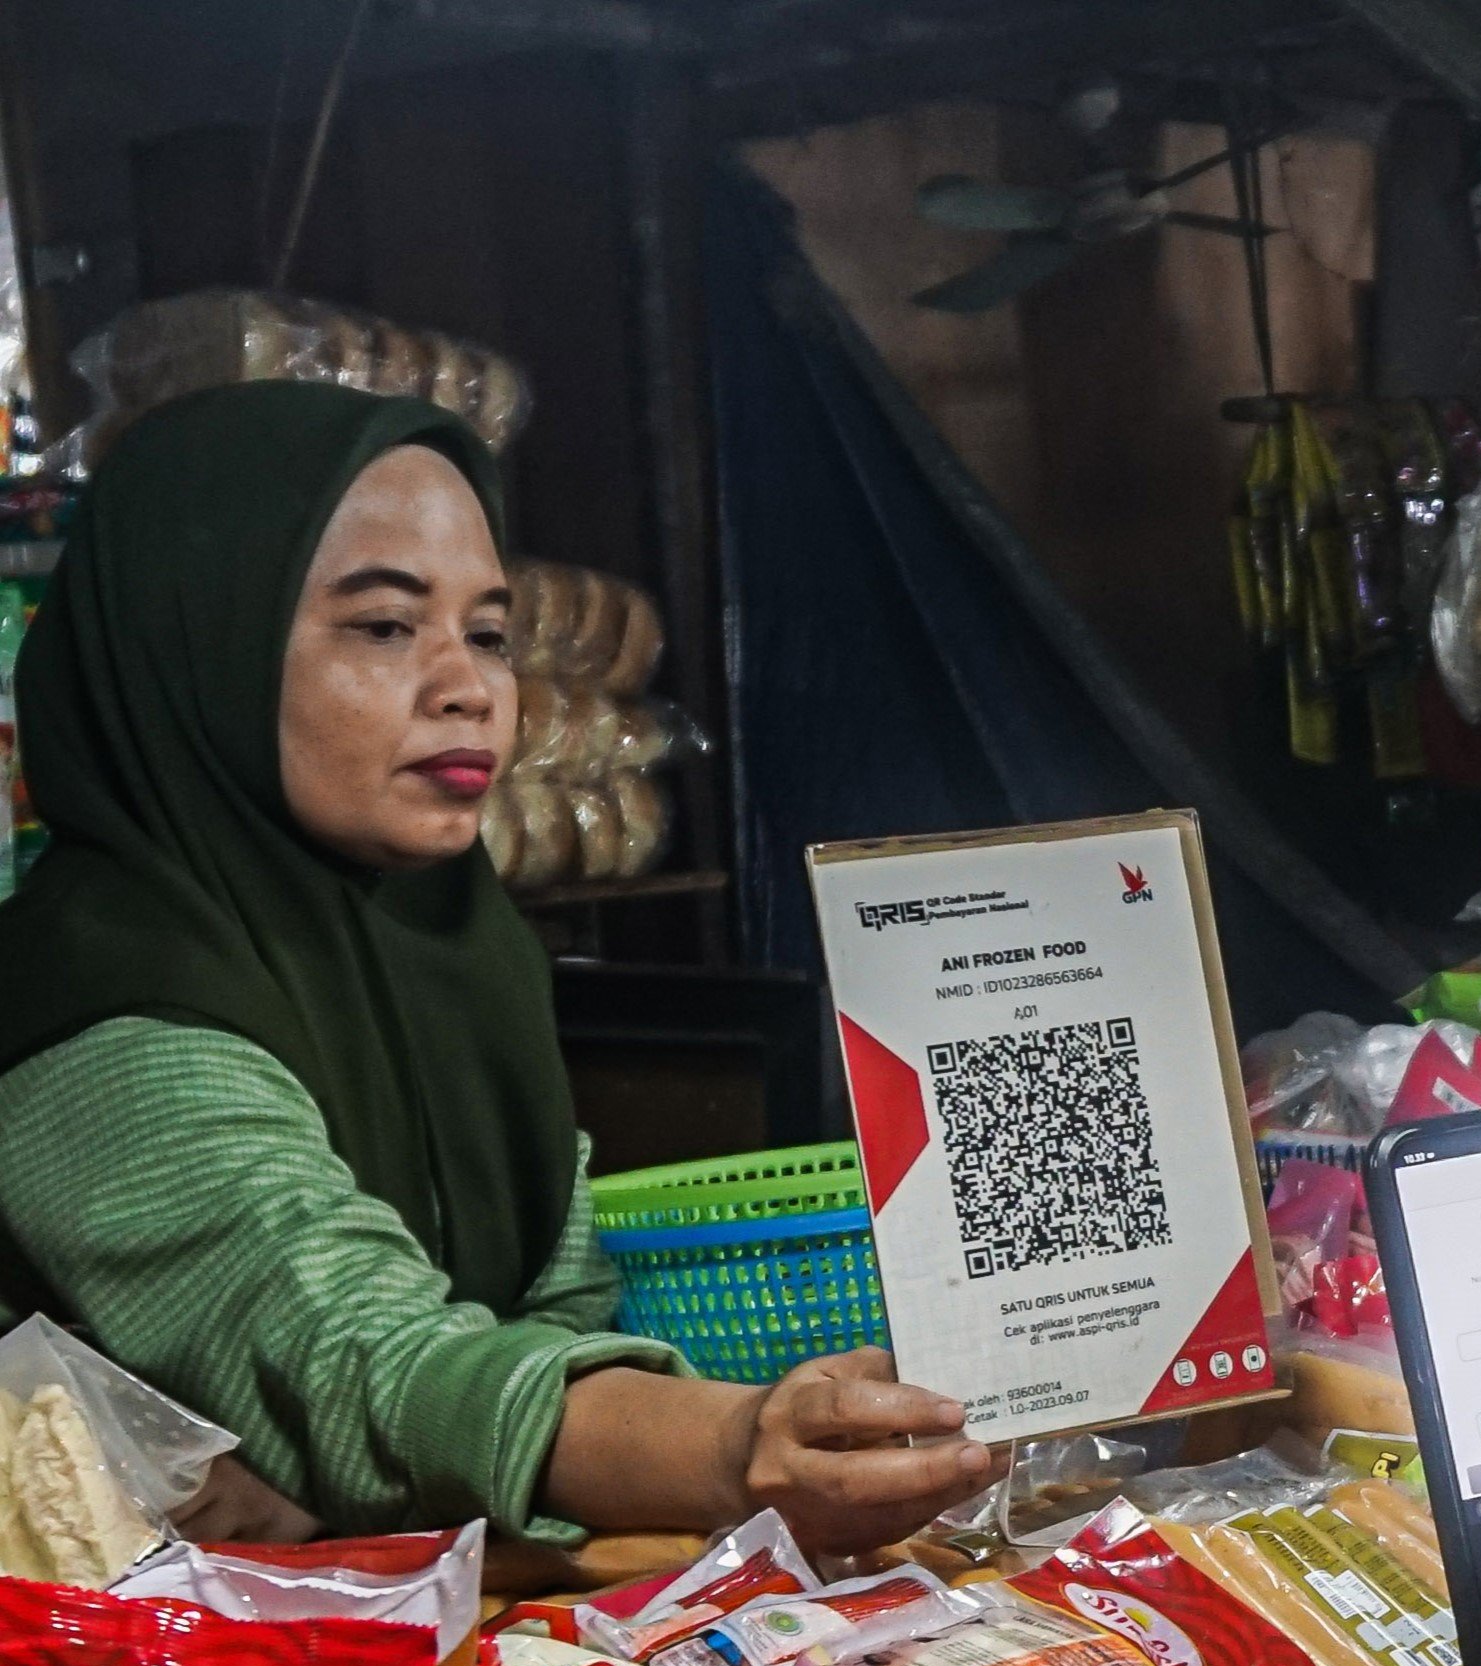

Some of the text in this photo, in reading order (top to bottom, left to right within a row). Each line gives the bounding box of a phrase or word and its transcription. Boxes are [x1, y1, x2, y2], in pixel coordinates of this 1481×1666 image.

[927, 899, 1029, 920] Pembayaran Nasional
[943, 893, 967, 906] Code
[968, 889, 1006, 902] Standar
[1121, 888, 1154, 904] GPN
[855, 899, 931, 931] QRIS
[941, 940, 1087, 973] ANI FROZEN FOOD
[935, 983, 974, 1001] NMID
[983, 965, 1104, 994] ID1023286563664
[1000, 1276, 1156, 1316] SATU QRIS UNTUK SEMUA
[1003, 1300, 1161, 1338] Cek aplikasi penyelenggara
[1048, 1315, 1140, 1342] www.aspi-qris.id
[977, 1393, 1000, 1408] oleh
[1006, 1380, 1063, 1402] 93600014
[966, 1410, 998, 1425] Cetak
